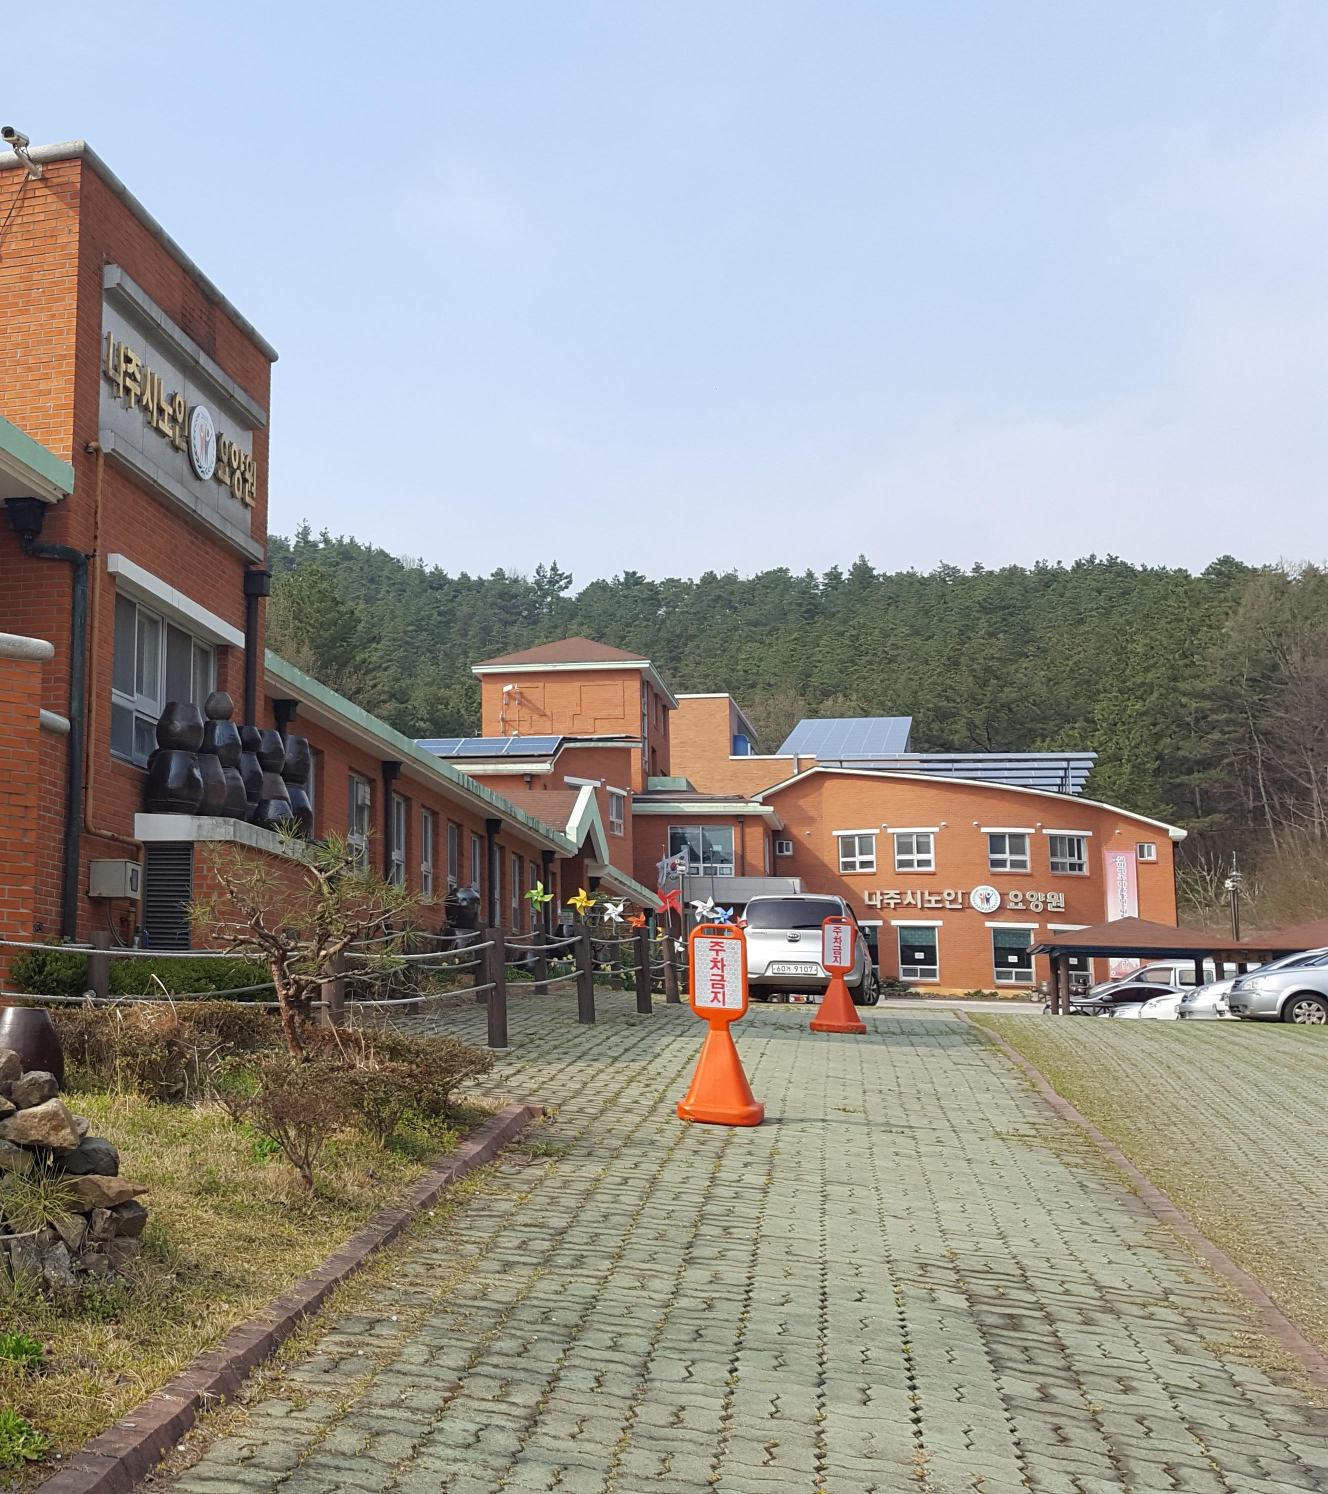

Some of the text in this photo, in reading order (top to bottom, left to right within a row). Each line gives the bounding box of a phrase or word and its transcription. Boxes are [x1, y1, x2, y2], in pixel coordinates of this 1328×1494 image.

[105, 331, 257, 508] 나주시노인 요양원
[864, 888, 1066, 913] 나주시노인 요양원
[832, 926, 842, 965] 주차금지
[709, 940, 726, 1007] 주차금지
[794, 965, 813, 973] 9107
